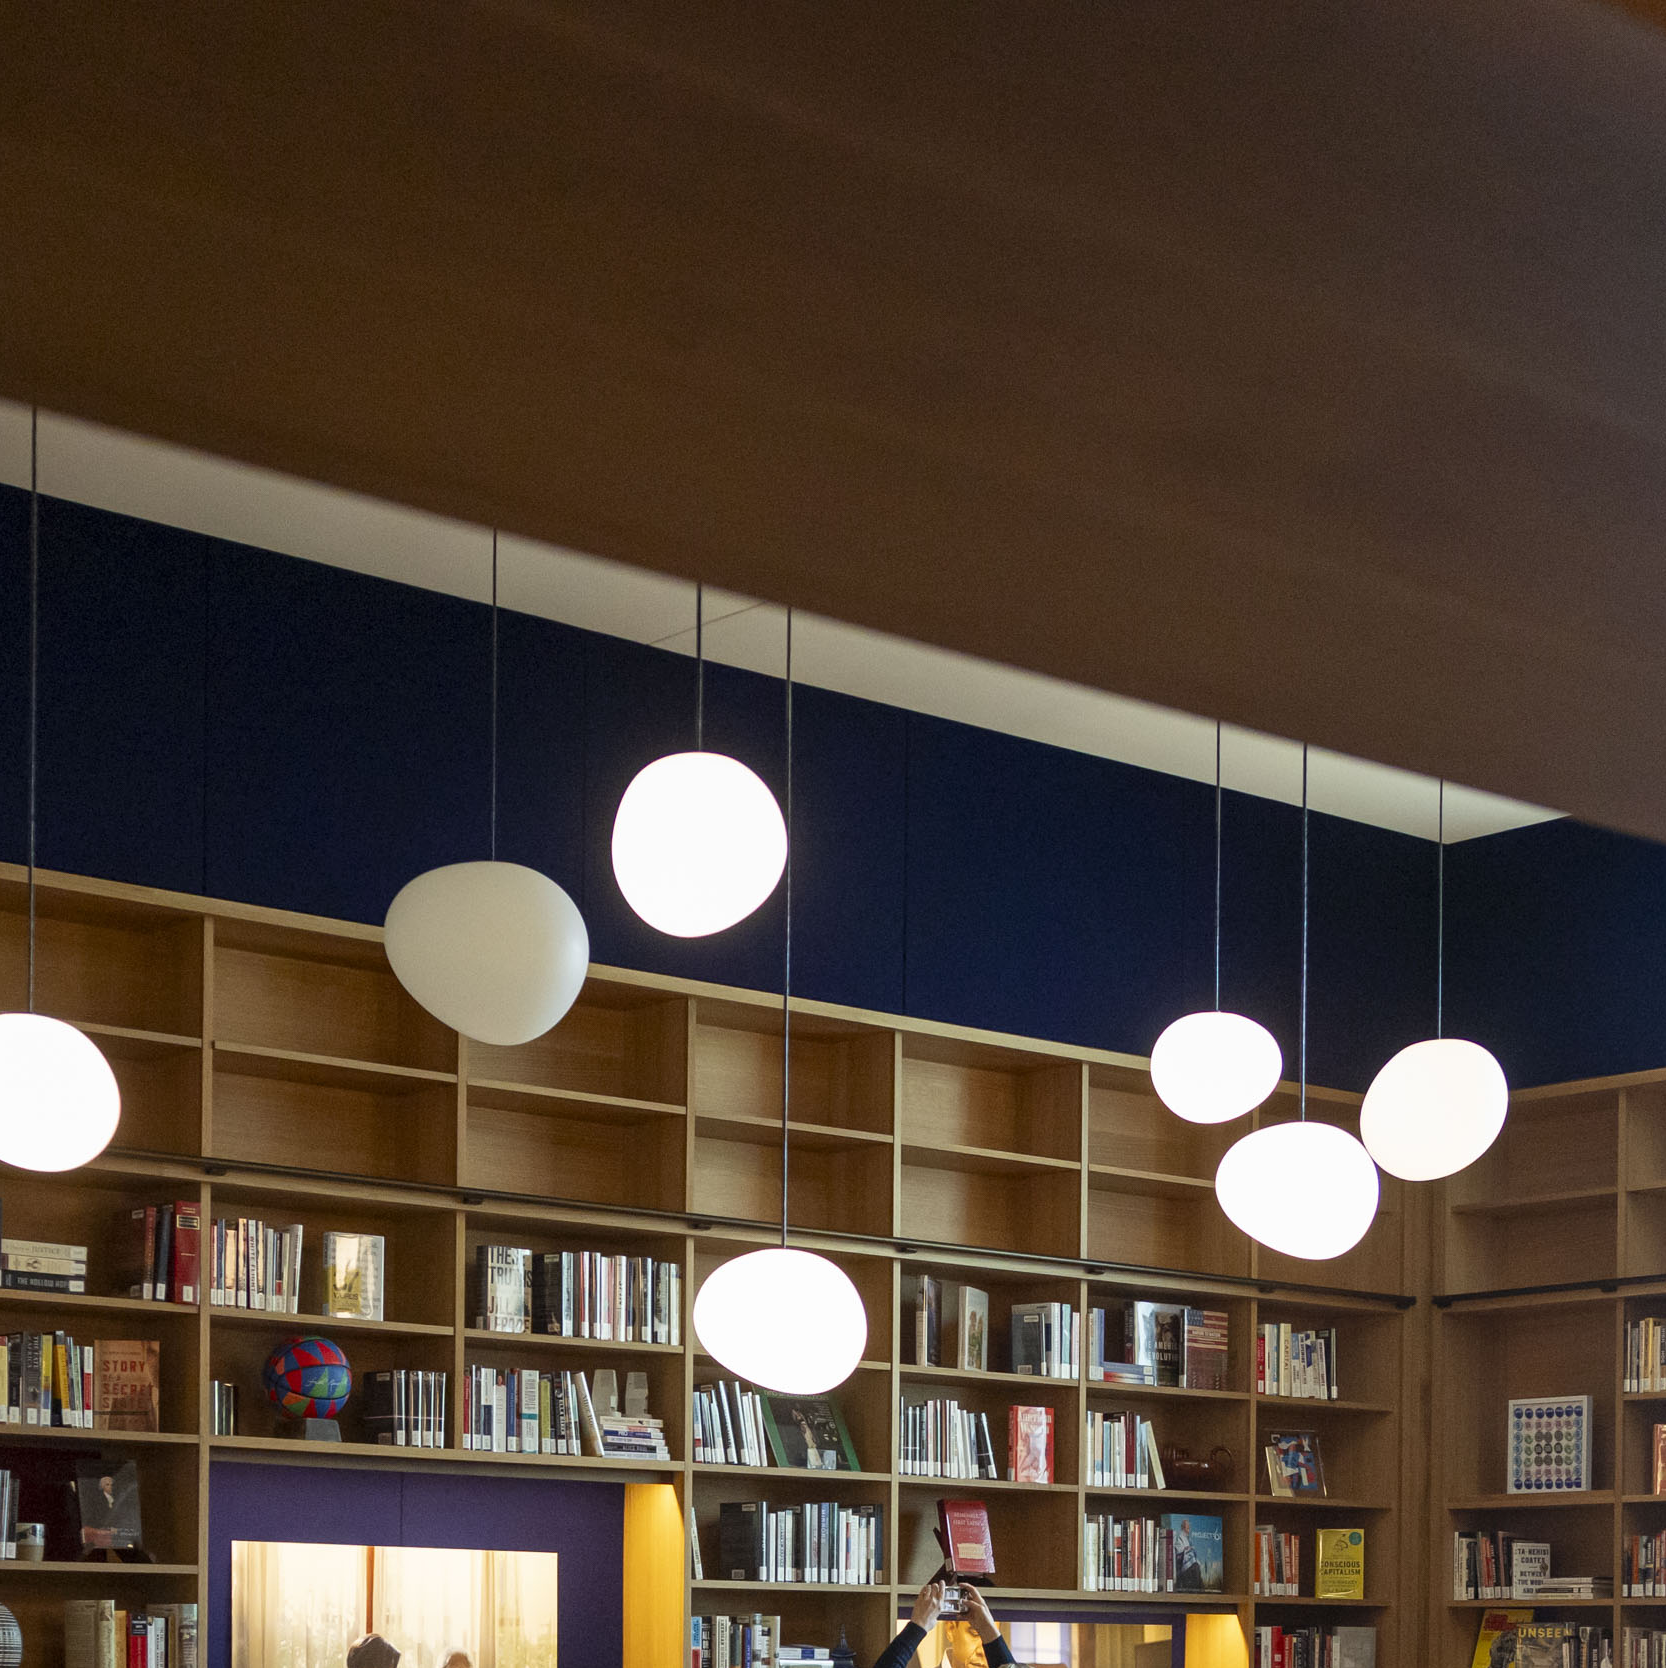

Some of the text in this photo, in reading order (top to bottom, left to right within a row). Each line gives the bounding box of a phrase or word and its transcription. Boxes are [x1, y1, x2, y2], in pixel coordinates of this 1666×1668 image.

[102, 1360, 146, 1373] STORY
[102, 1382, 153, 1396] SECRET
[1320, 1560, 1361, 1568] CONSCIOUS
[1320, 1568, 1361, 1576] CAPITALISM
[1518, 1627, 1573, 1638] UNSEEN
